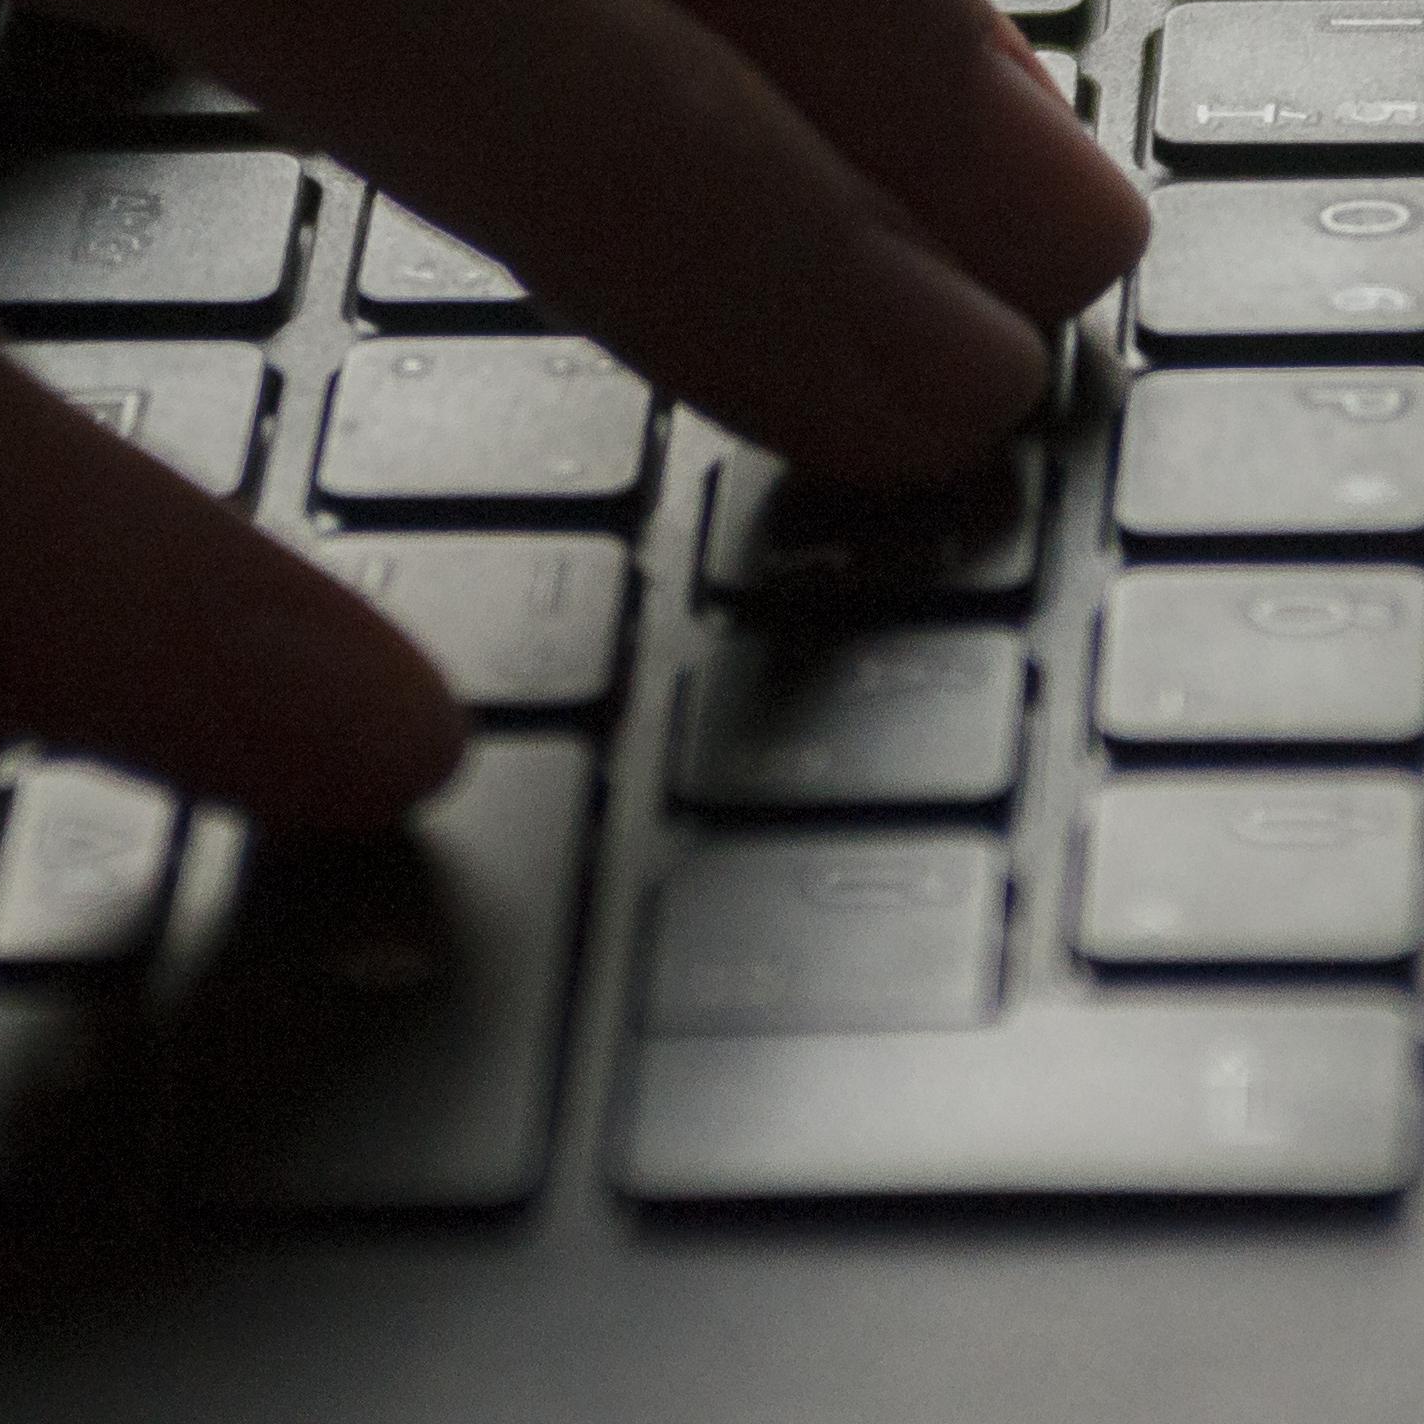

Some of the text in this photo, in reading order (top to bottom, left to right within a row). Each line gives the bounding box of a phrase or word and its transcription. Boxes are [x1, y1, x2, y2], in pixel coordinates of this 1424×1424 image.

[1319, 200, 1412, 234] O
[1332, 287, 1412, 312] 6
[1303, 387, 1402, 414] P
